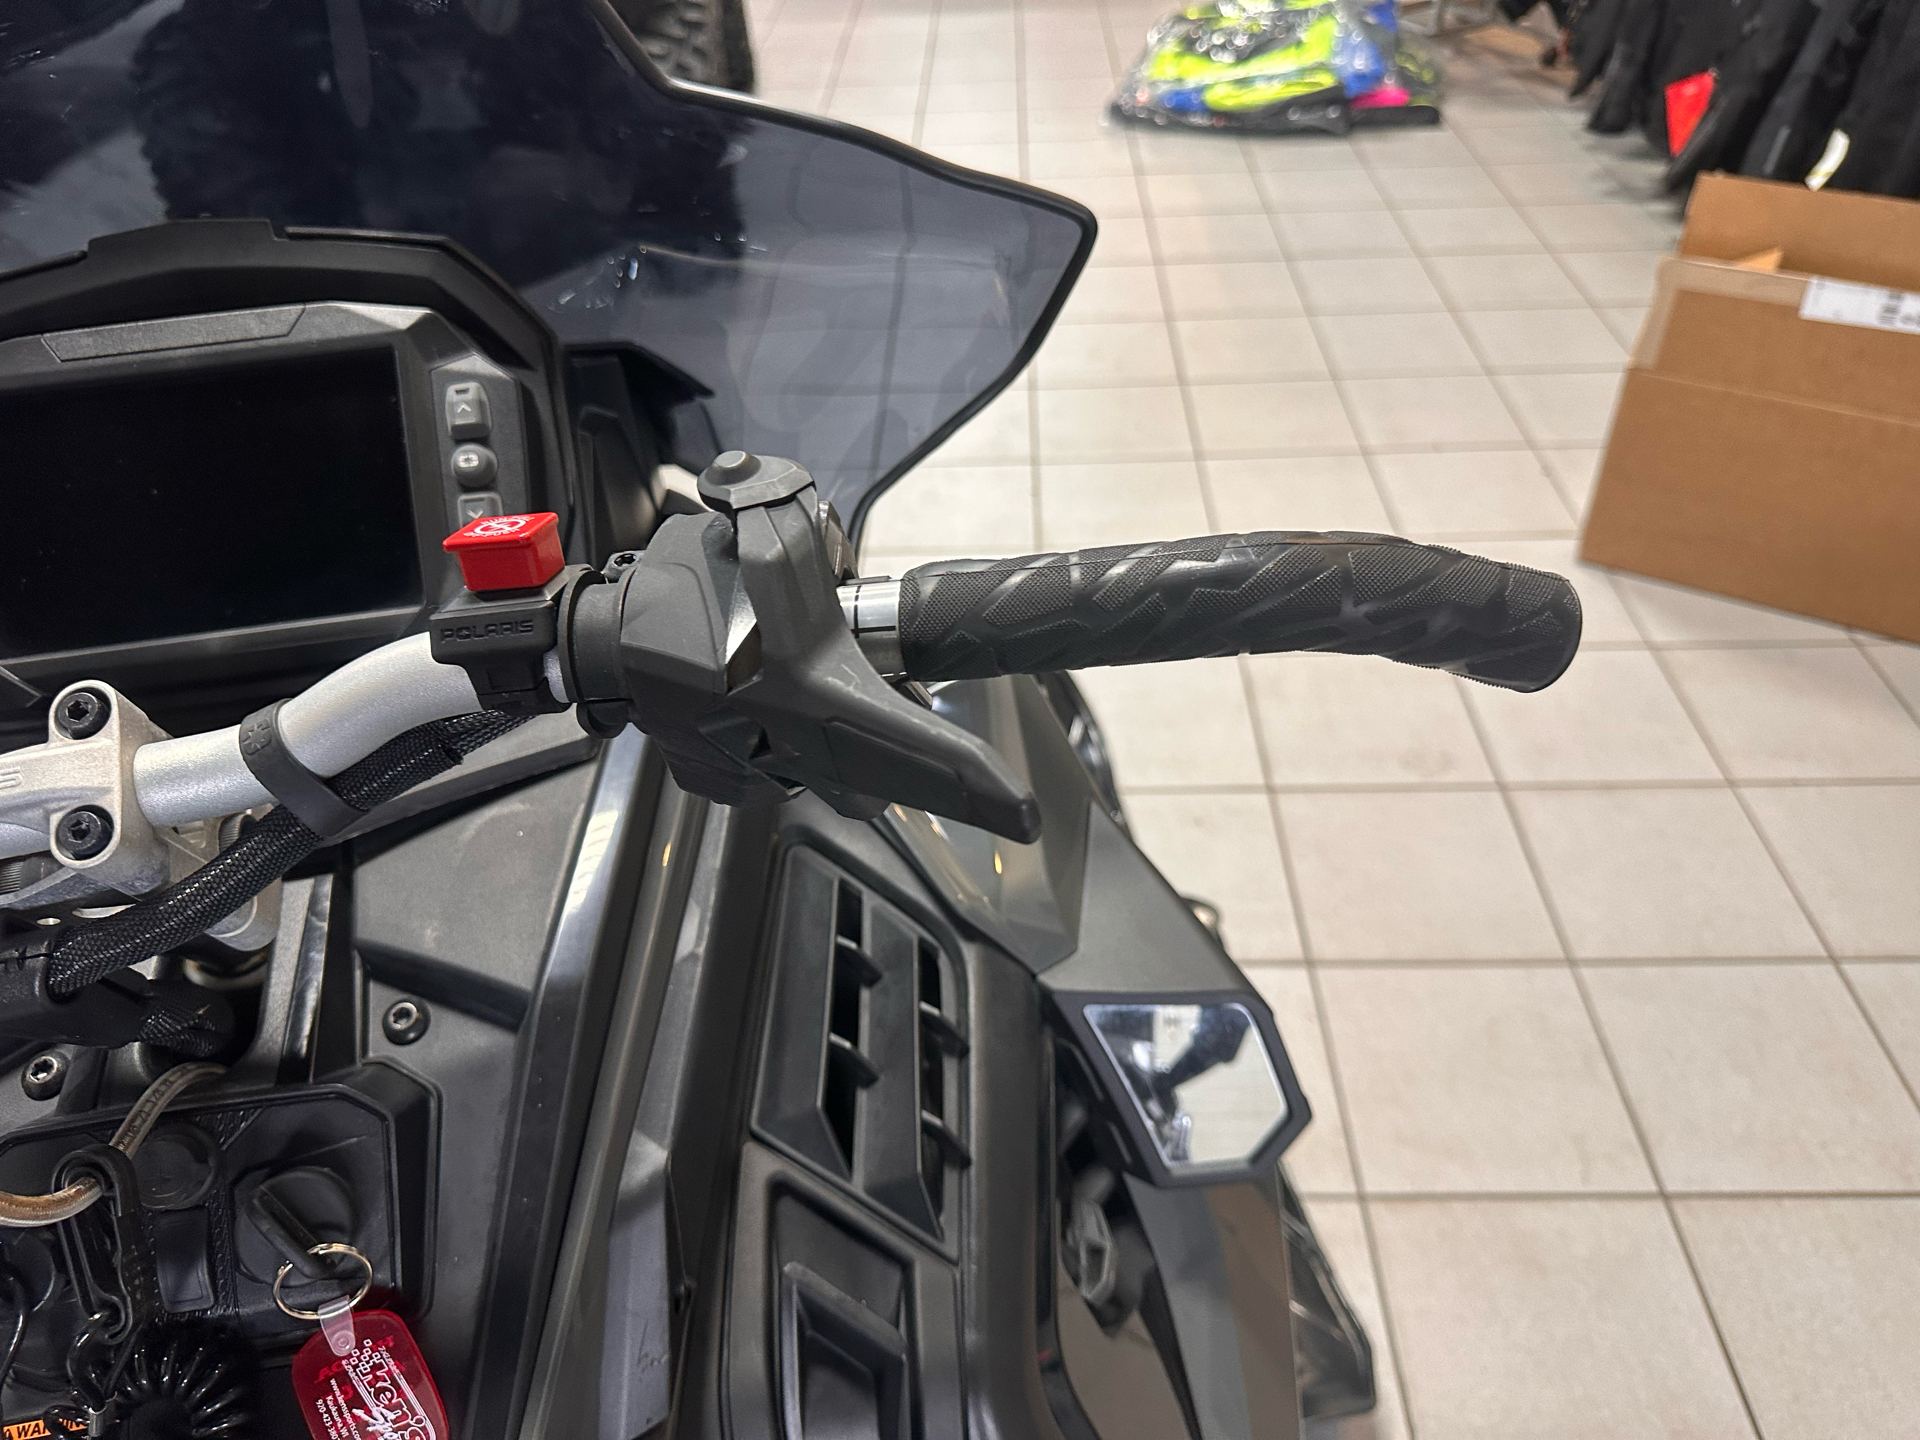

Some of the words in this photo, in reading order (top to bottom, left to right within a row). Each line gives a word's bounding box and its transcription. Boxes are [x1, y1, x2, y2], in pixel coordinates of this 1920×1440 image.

[440, 619, 534, 643] POLARIS
[316, 1399, 340, 1440] 920-423-380
[330, 1378, 361, 1440] www.kenssports.co
